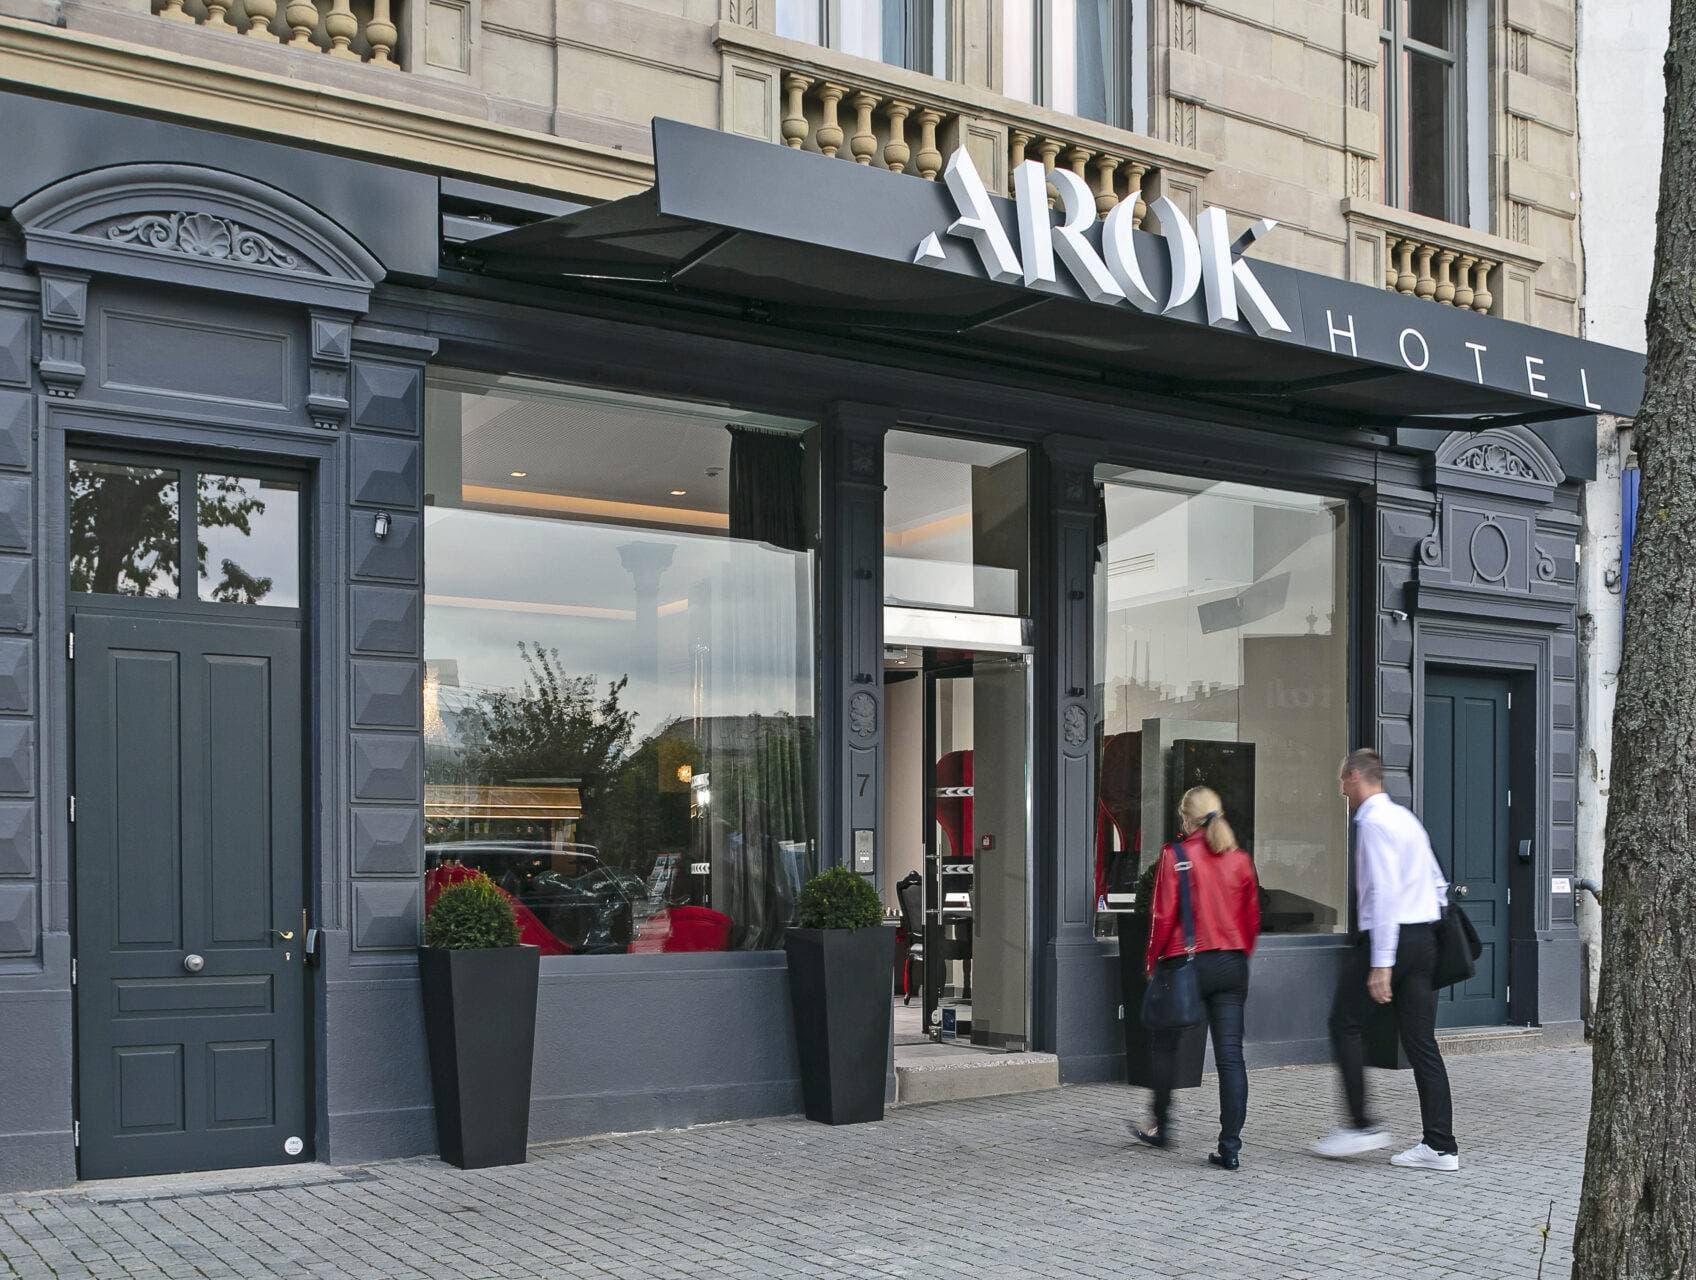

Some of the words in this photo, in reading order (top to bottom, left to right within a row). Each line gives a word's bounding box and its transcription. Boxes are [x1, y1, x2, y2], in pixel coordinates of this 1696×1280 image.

[913, 144, 1291, 336] AROK
[1326, 309, 1601, 410] HOTEL
[856, 773, 870, 797] 7
